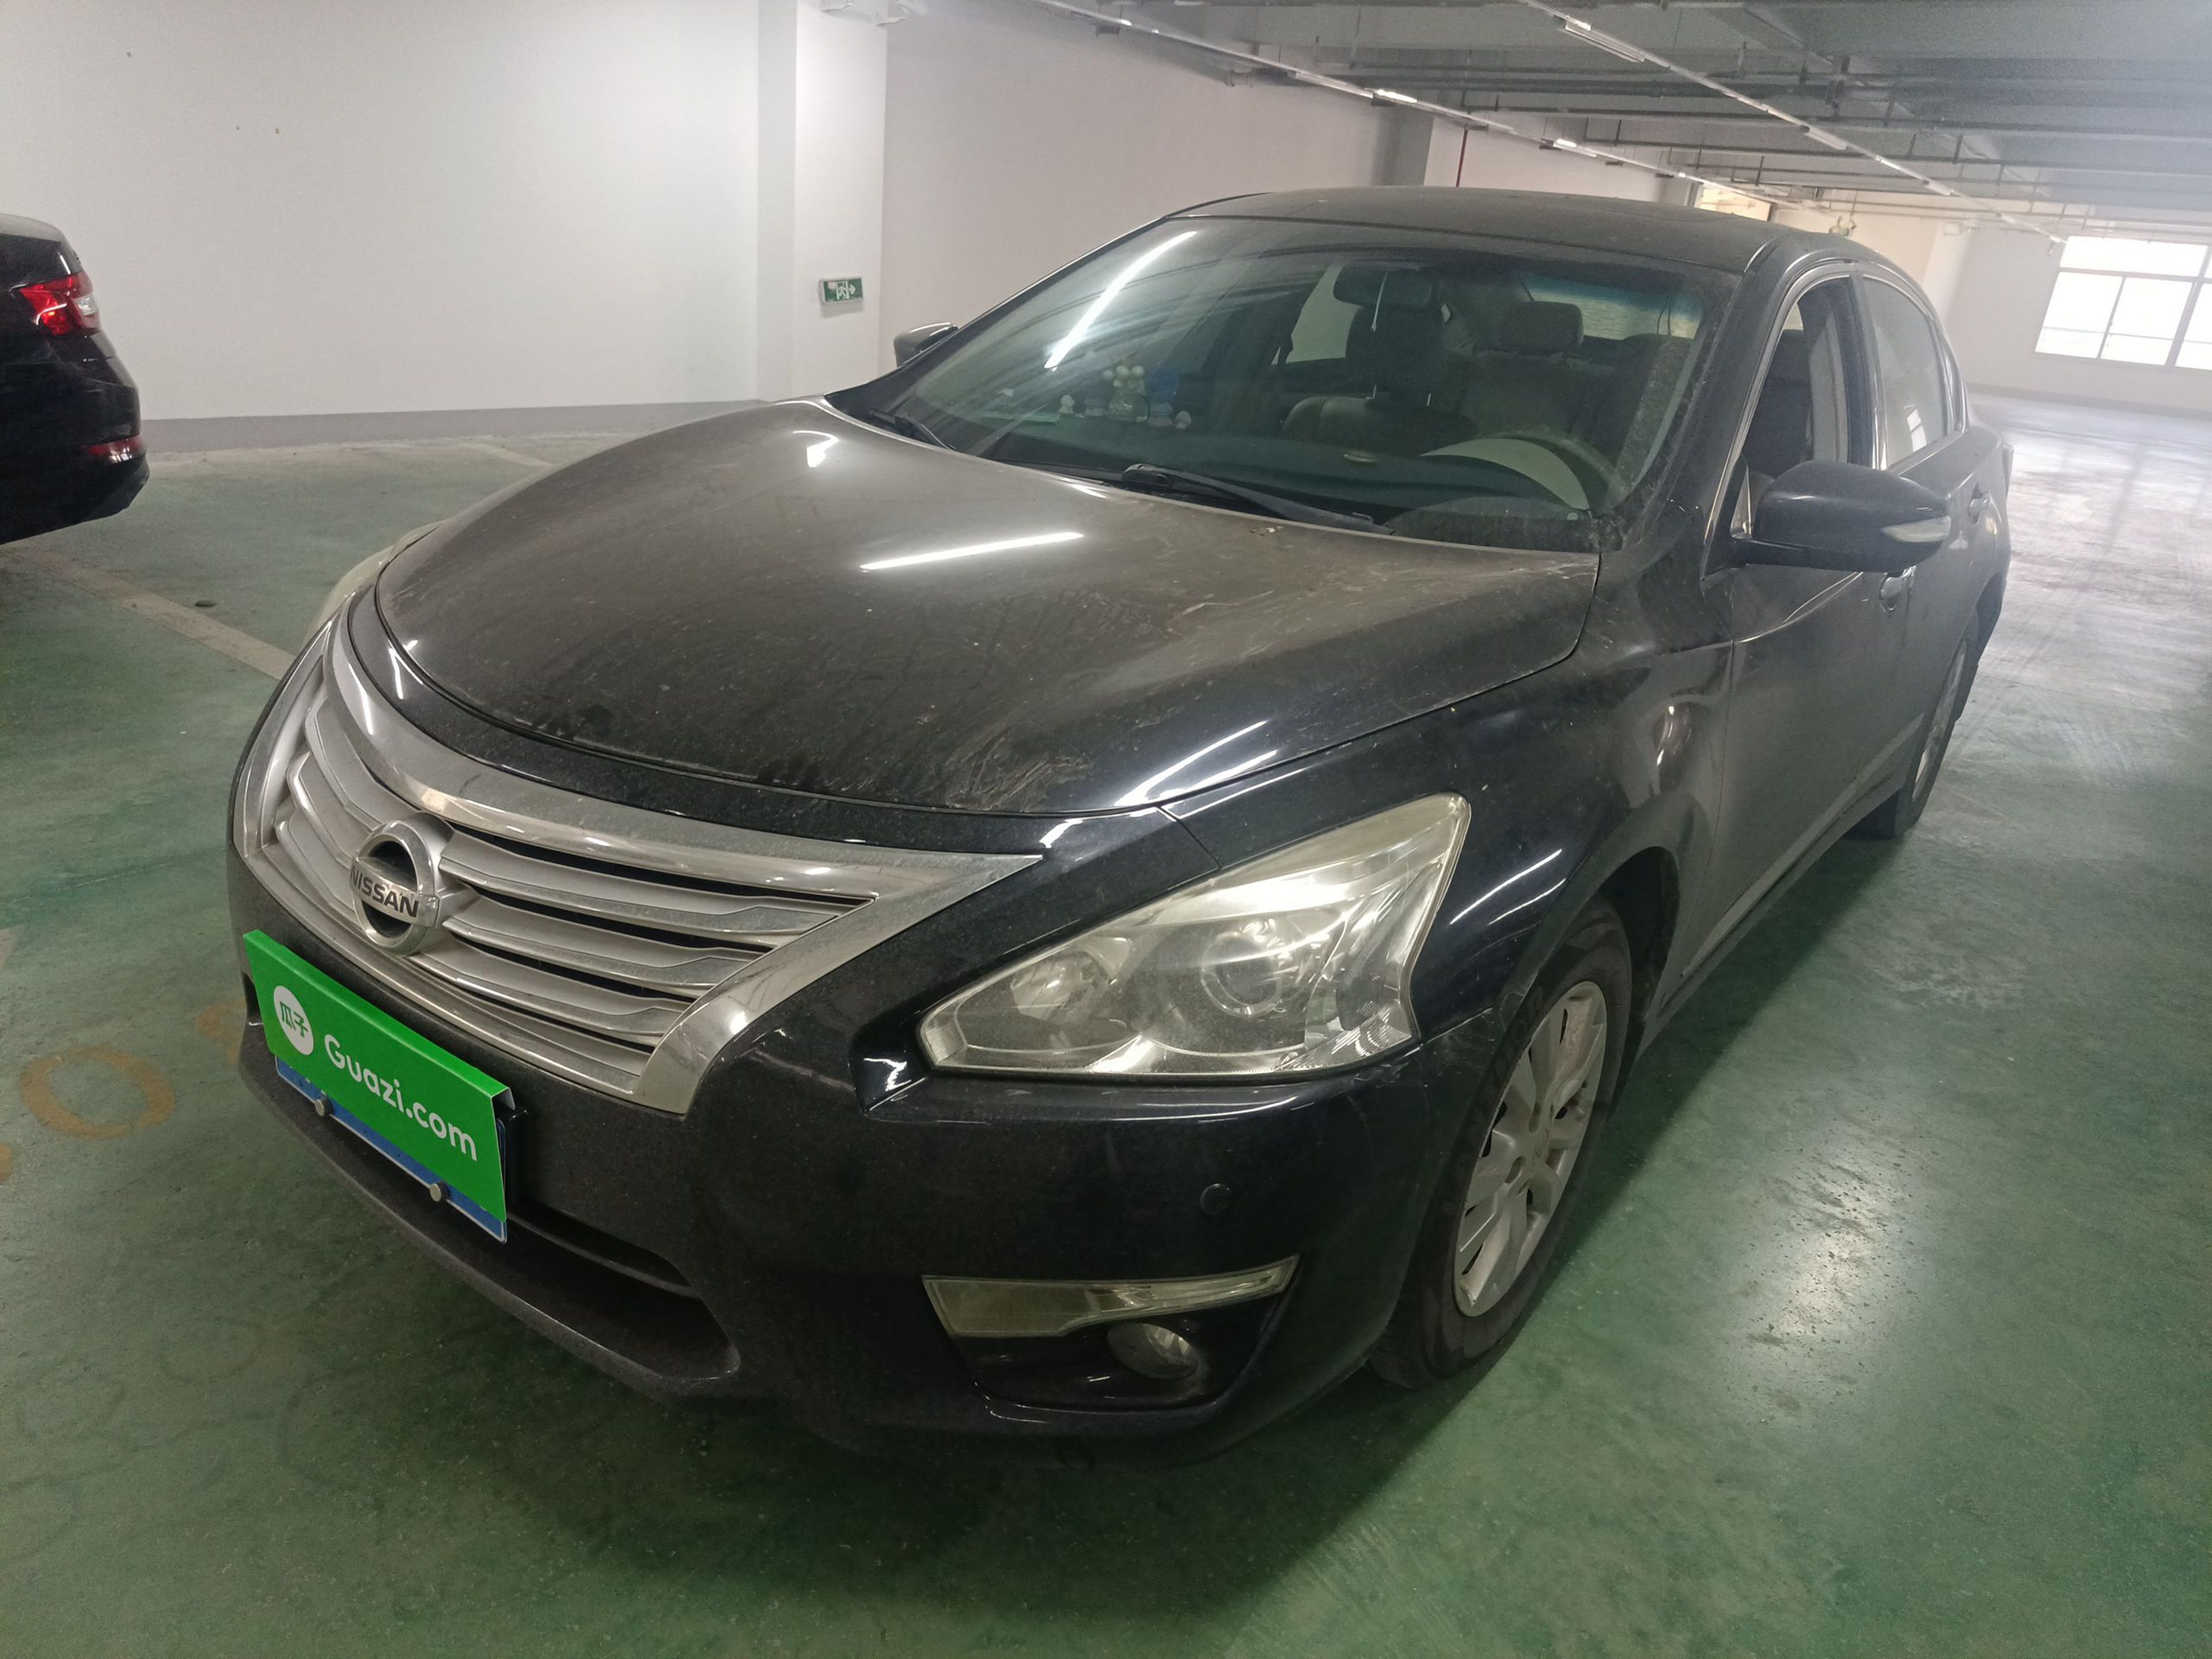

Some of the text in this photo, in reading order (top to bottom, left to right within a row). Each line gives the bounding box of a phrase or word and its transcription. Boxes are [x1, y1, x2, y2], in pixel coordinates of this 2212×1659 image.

[350, 864, 419, 918] NISSAN
[279, 1001, 308, 1038] 瓜子
[324, 1034, 477, 1161] Guazi.com
